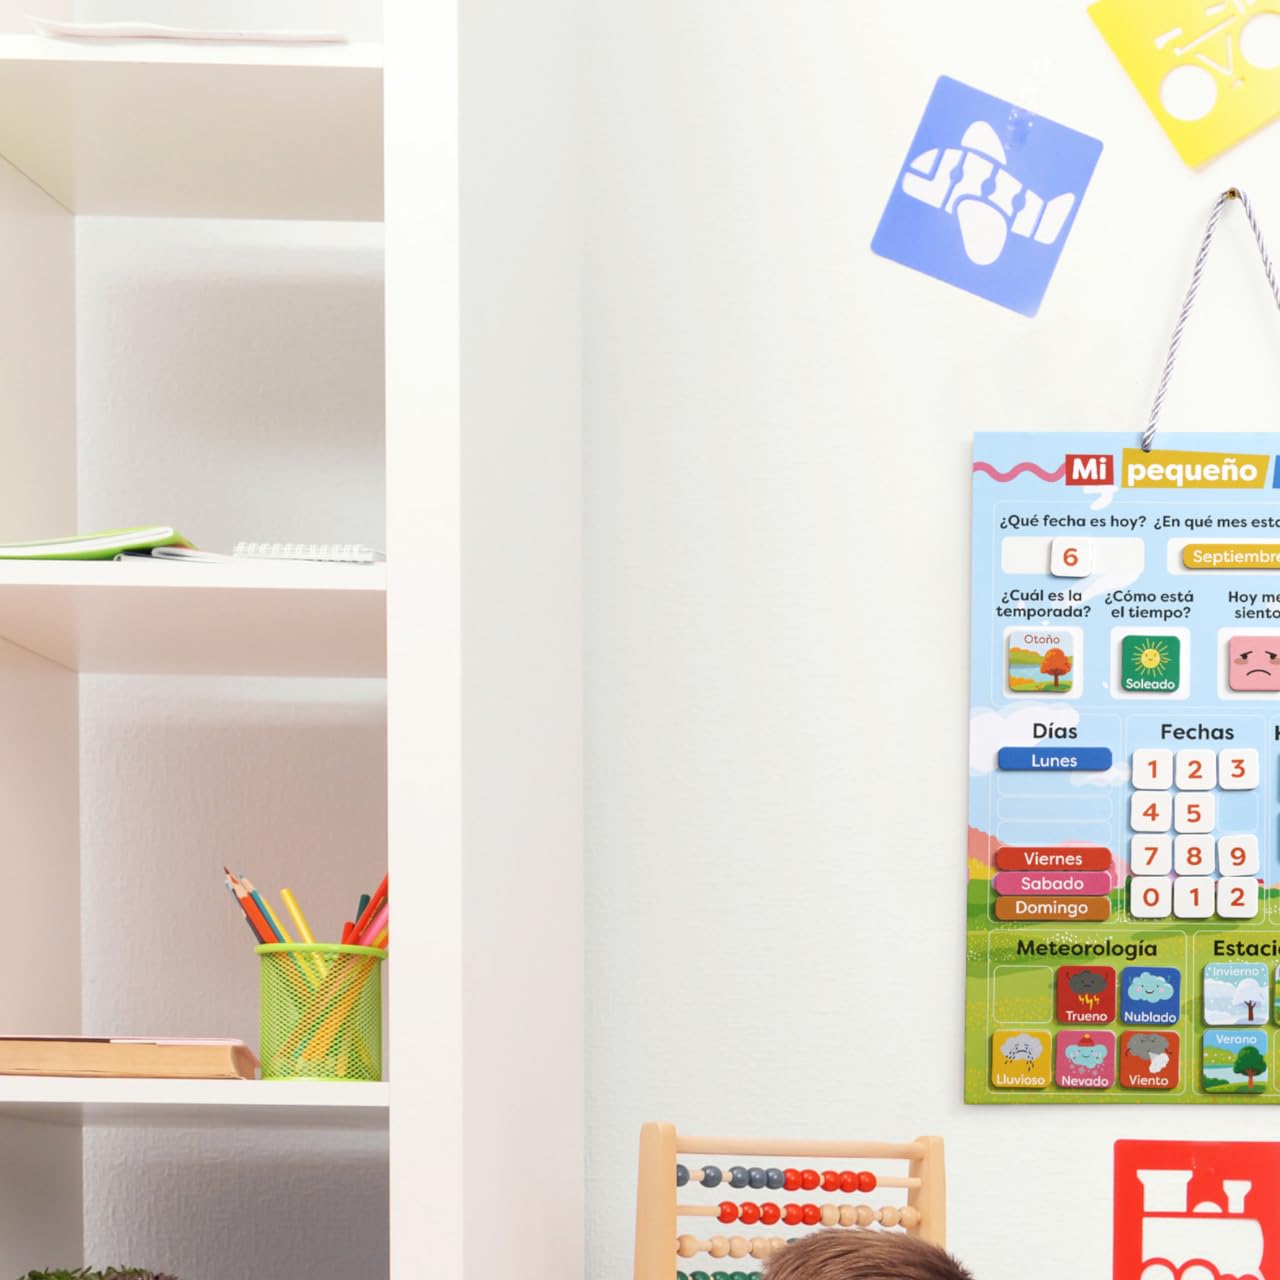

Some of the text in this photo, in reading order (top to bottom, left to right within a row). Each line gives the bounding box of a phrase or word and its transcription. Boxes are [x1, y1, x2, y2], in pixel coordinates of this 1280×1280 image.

[1072, 457, 1106, 481] Mi
[1128, 458, 1258, 487] pequeño
[999, 515, 1147, 530] ¿Qué fecha es hoy?
[1154, 516, 1180, 529] ¿En
[1185, 515, 1213, 531] qué
[1217, 518, 1247, 529] mes
[1062, 547, 1079, 566] 6
[1001, 589, 1082, 605] ¿Cuál es la
[1105, 589, 1194, 605] ¿Cómo está
[1228, 591, 1257, 606] Hoy
[996, 605, 1091, 620] temporada?
[1111, 606, 1191, 621] el tiempo?
[1024, 633, 1060, 645] Otoño
[1126, 678, 1175, 691] Soleado
[1033, 723, 1077, 740] Días
[1160, 723, 1234, 741] Fechas
[1031, 753, 1077, 767] Lunes
[1147, 760, 1245, 778] 1 2 3
[1142, 803, 1201, 822] 4 5
[1024, 851, 1083, 865] Viernes
[1144, 847, 1246, 865] 7 8 9
[1021, 876, 1084, 890] Sabado
[1143, 888, 1245, 907] 0 1 2
[1016, 900, 1088, 918] Domingo
[1017, 939, 1157, 960] Meteorología
[1213, 966, 1260, 977] Invierno
[1065, 1010, 1108, 1022] Trueno
[1125, 1010, 1177, 1023] Nublado
[1216, 1034, 1257, 1045] Verano
[996, 1073, 1045, 1086] Lluvioso
[1062, 1075, 1109, 1088] Nevado
[1129, 1075, 1169, 1086] Viento
